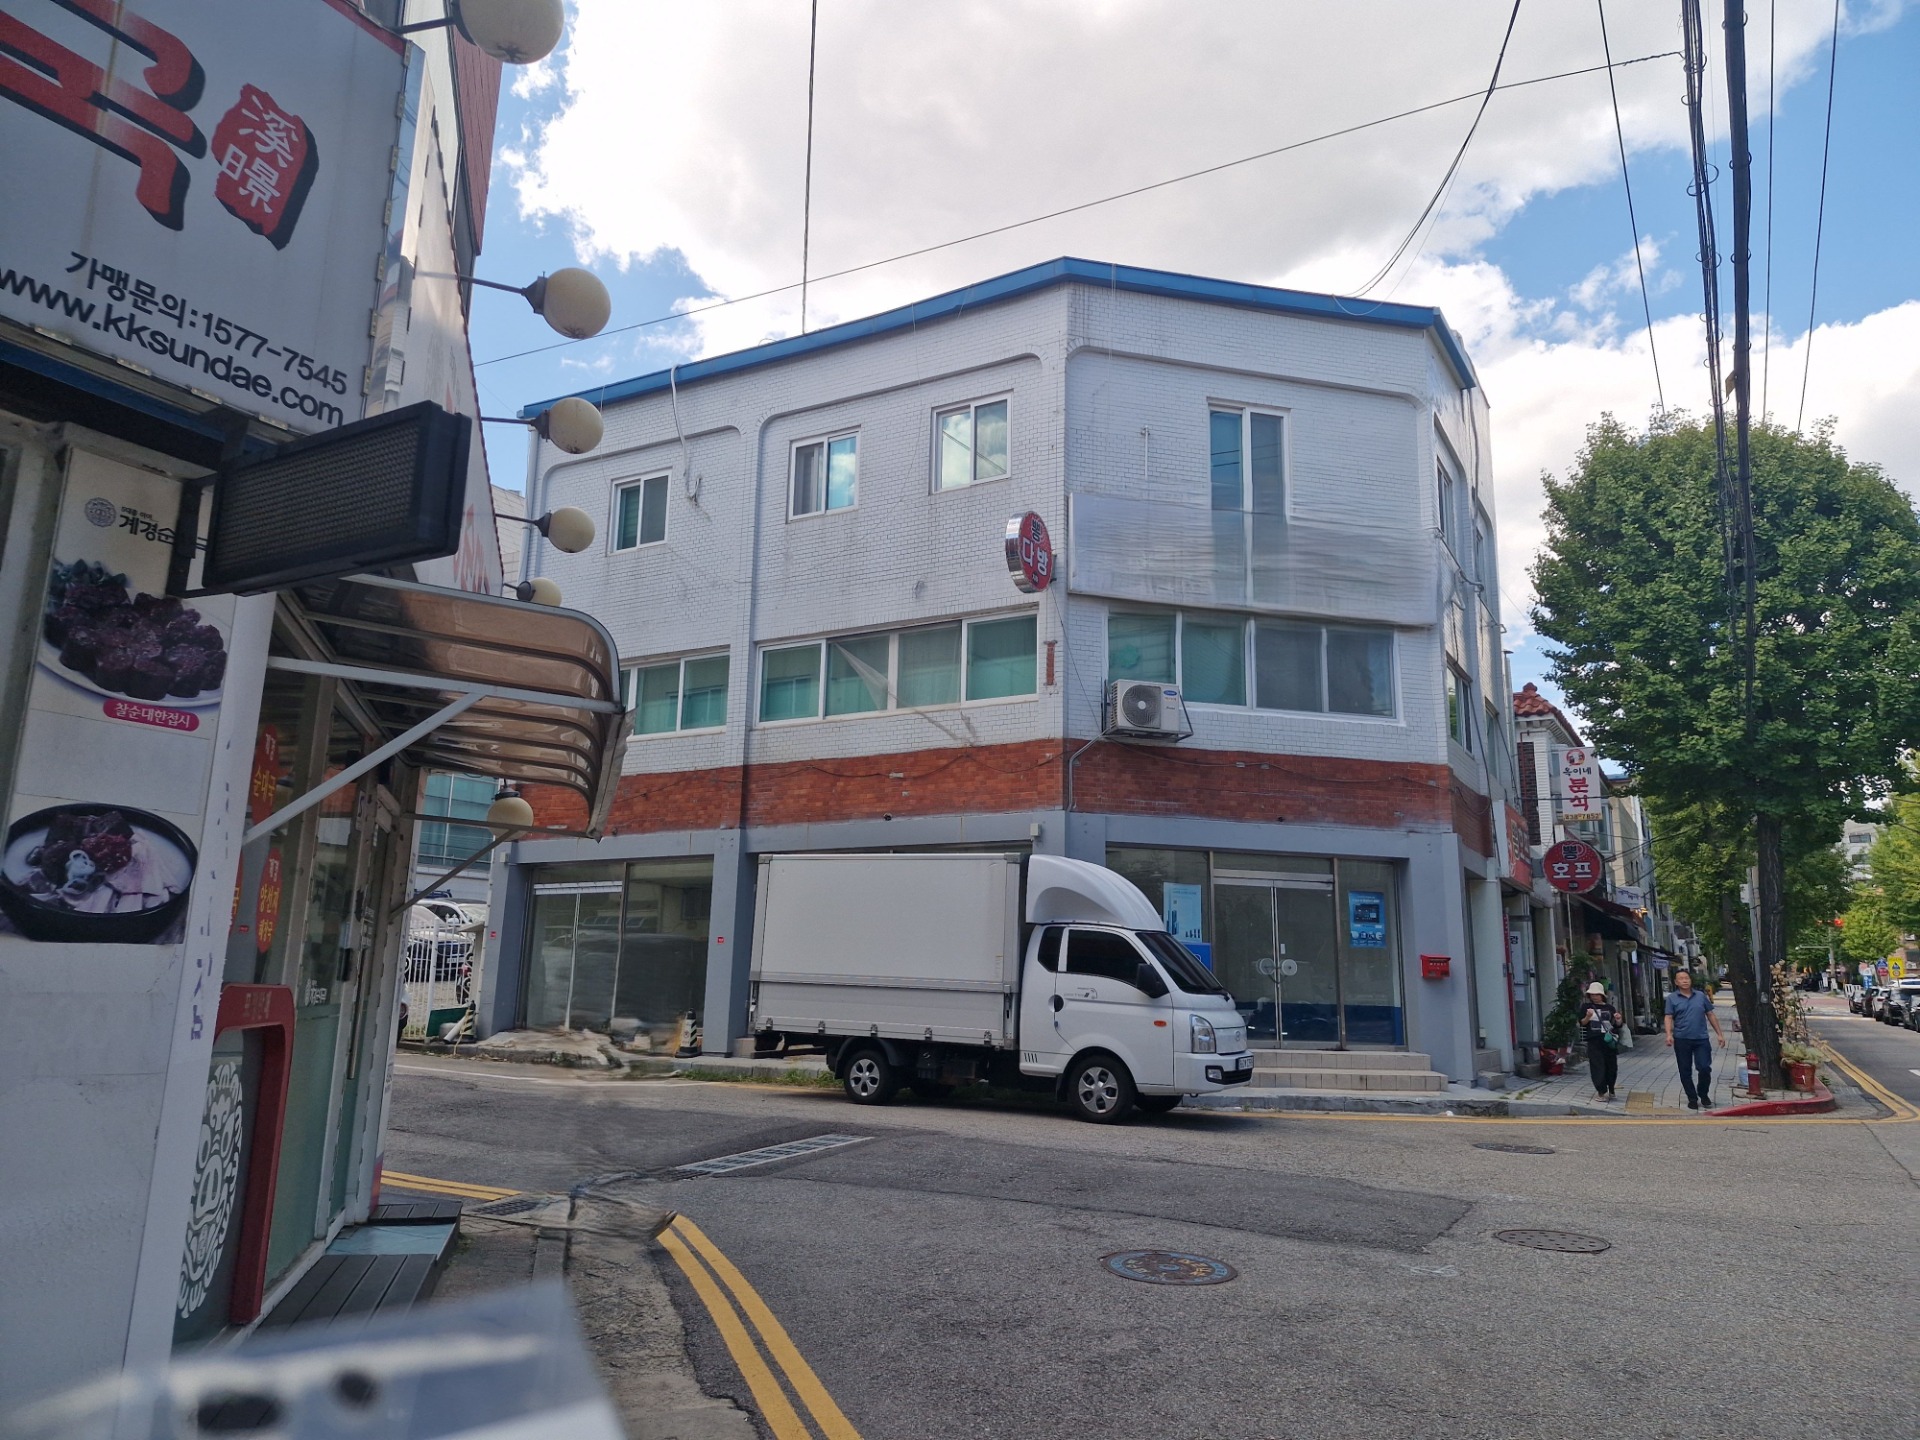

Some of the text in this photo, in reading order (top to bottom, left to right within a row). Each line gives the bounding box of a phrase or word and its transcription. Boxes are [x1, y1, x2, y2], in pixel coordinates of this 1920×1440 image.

[0, 267, 344, 428] www.kksundae.com
[1563, 767, 1592, 776] 옥이네
[1568, 777, 1589, 811] 분식
[1552, 862, 1593, 878] 호프
